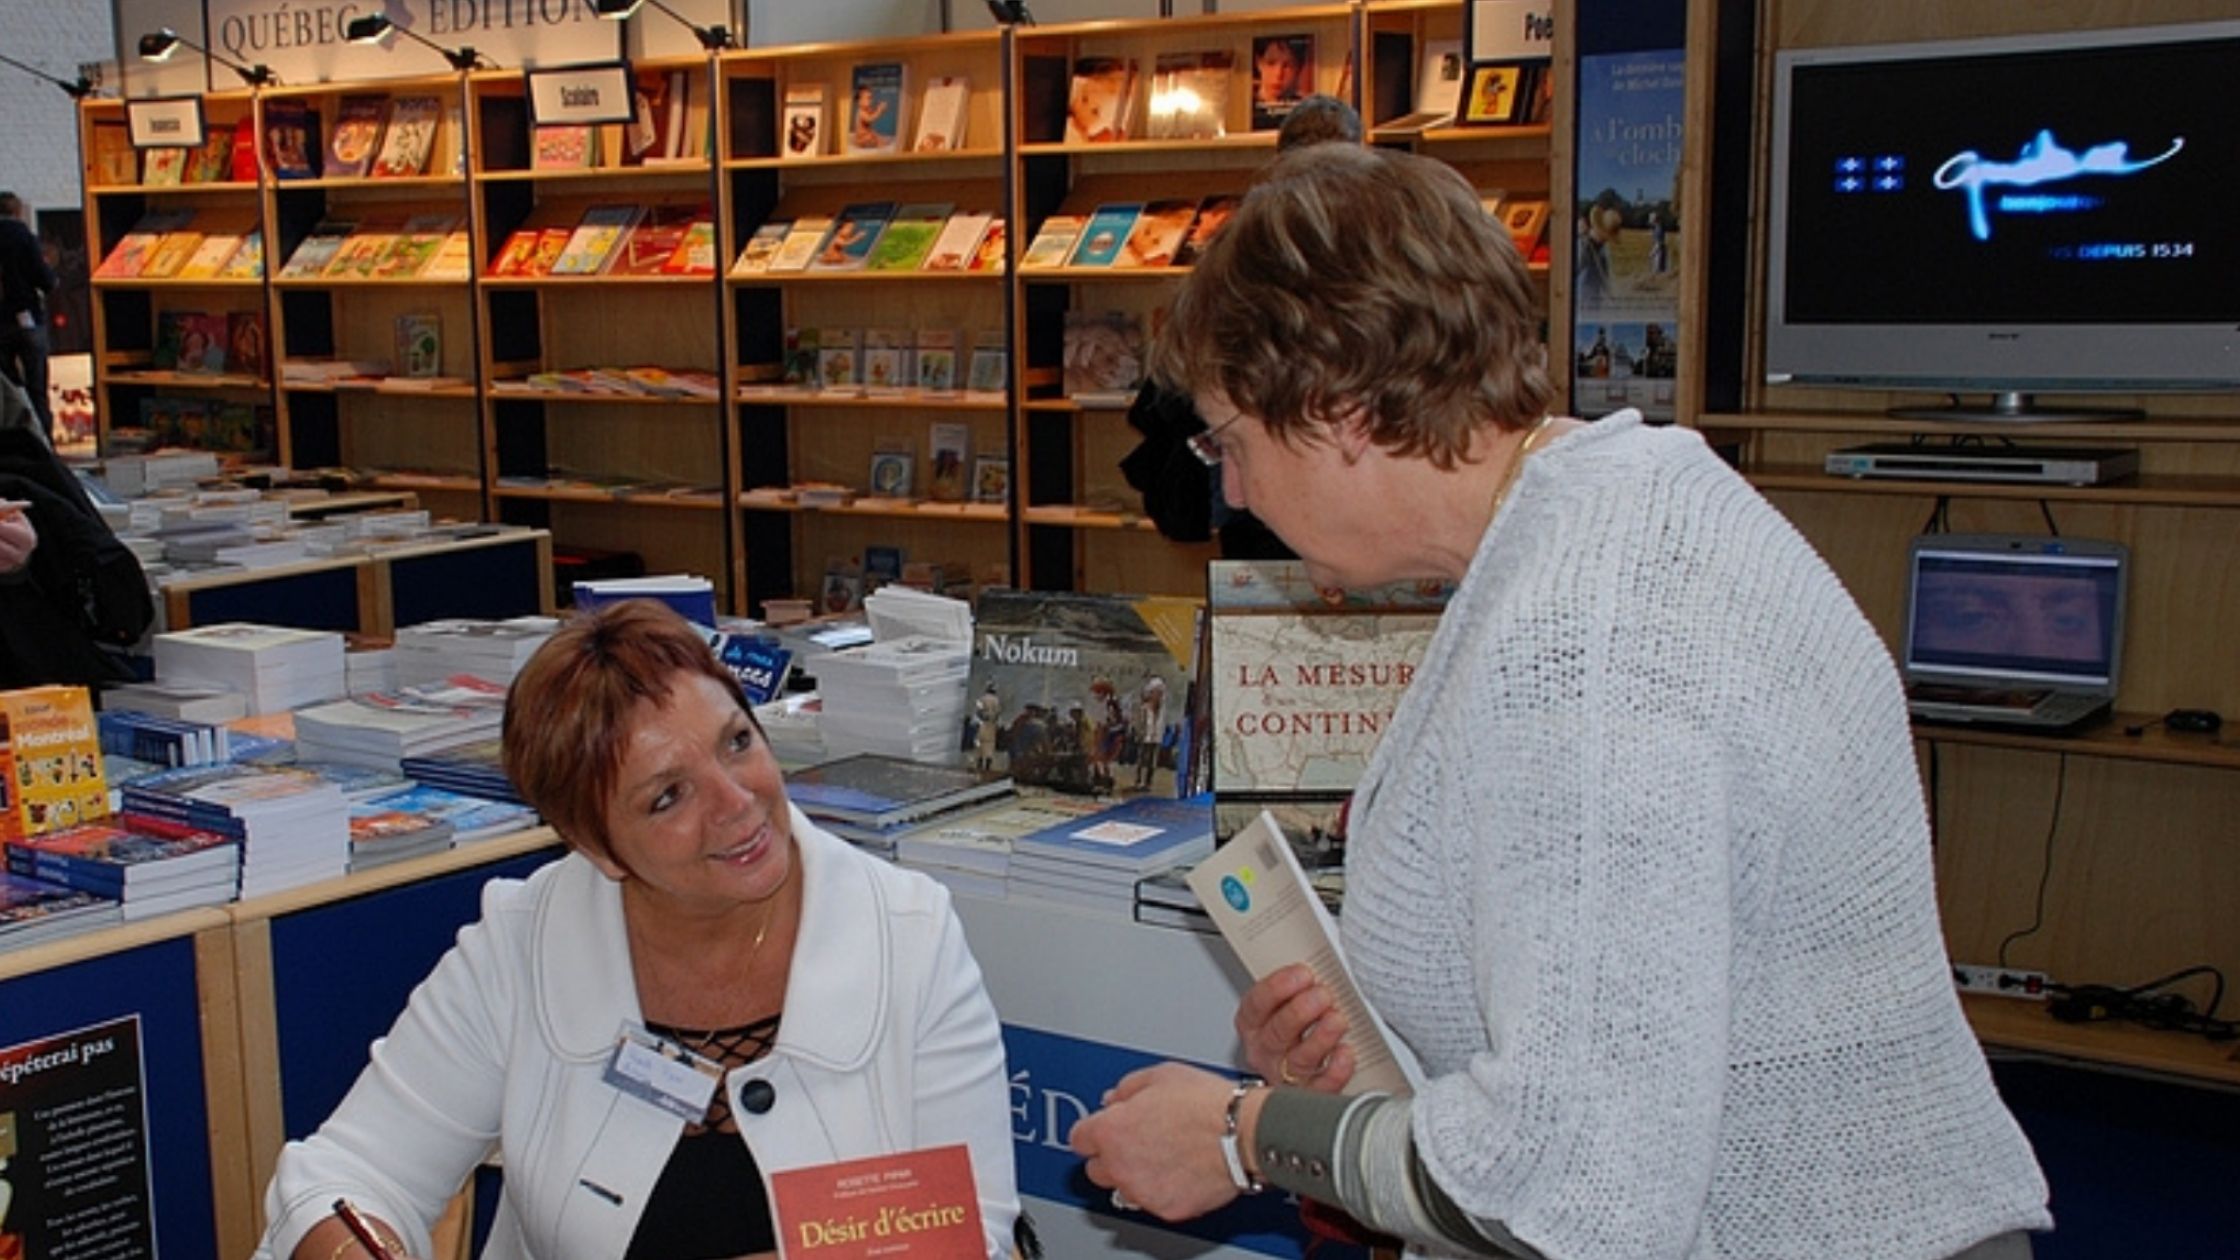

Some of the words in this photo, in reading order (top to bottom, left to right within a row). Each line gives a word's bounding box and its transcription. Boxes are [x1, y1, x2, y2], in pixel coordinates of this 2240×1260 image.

[983, 633, 1078, 666] Nokum
[1240, 664, 1279, 687] LA
[1236, 711, 1393, 735] CONTIN
[81, 1035, 115, 1065] pas
[800, 1216, 869, 1249] Désir
[874, 1202, 965, 1237] d'écrire
